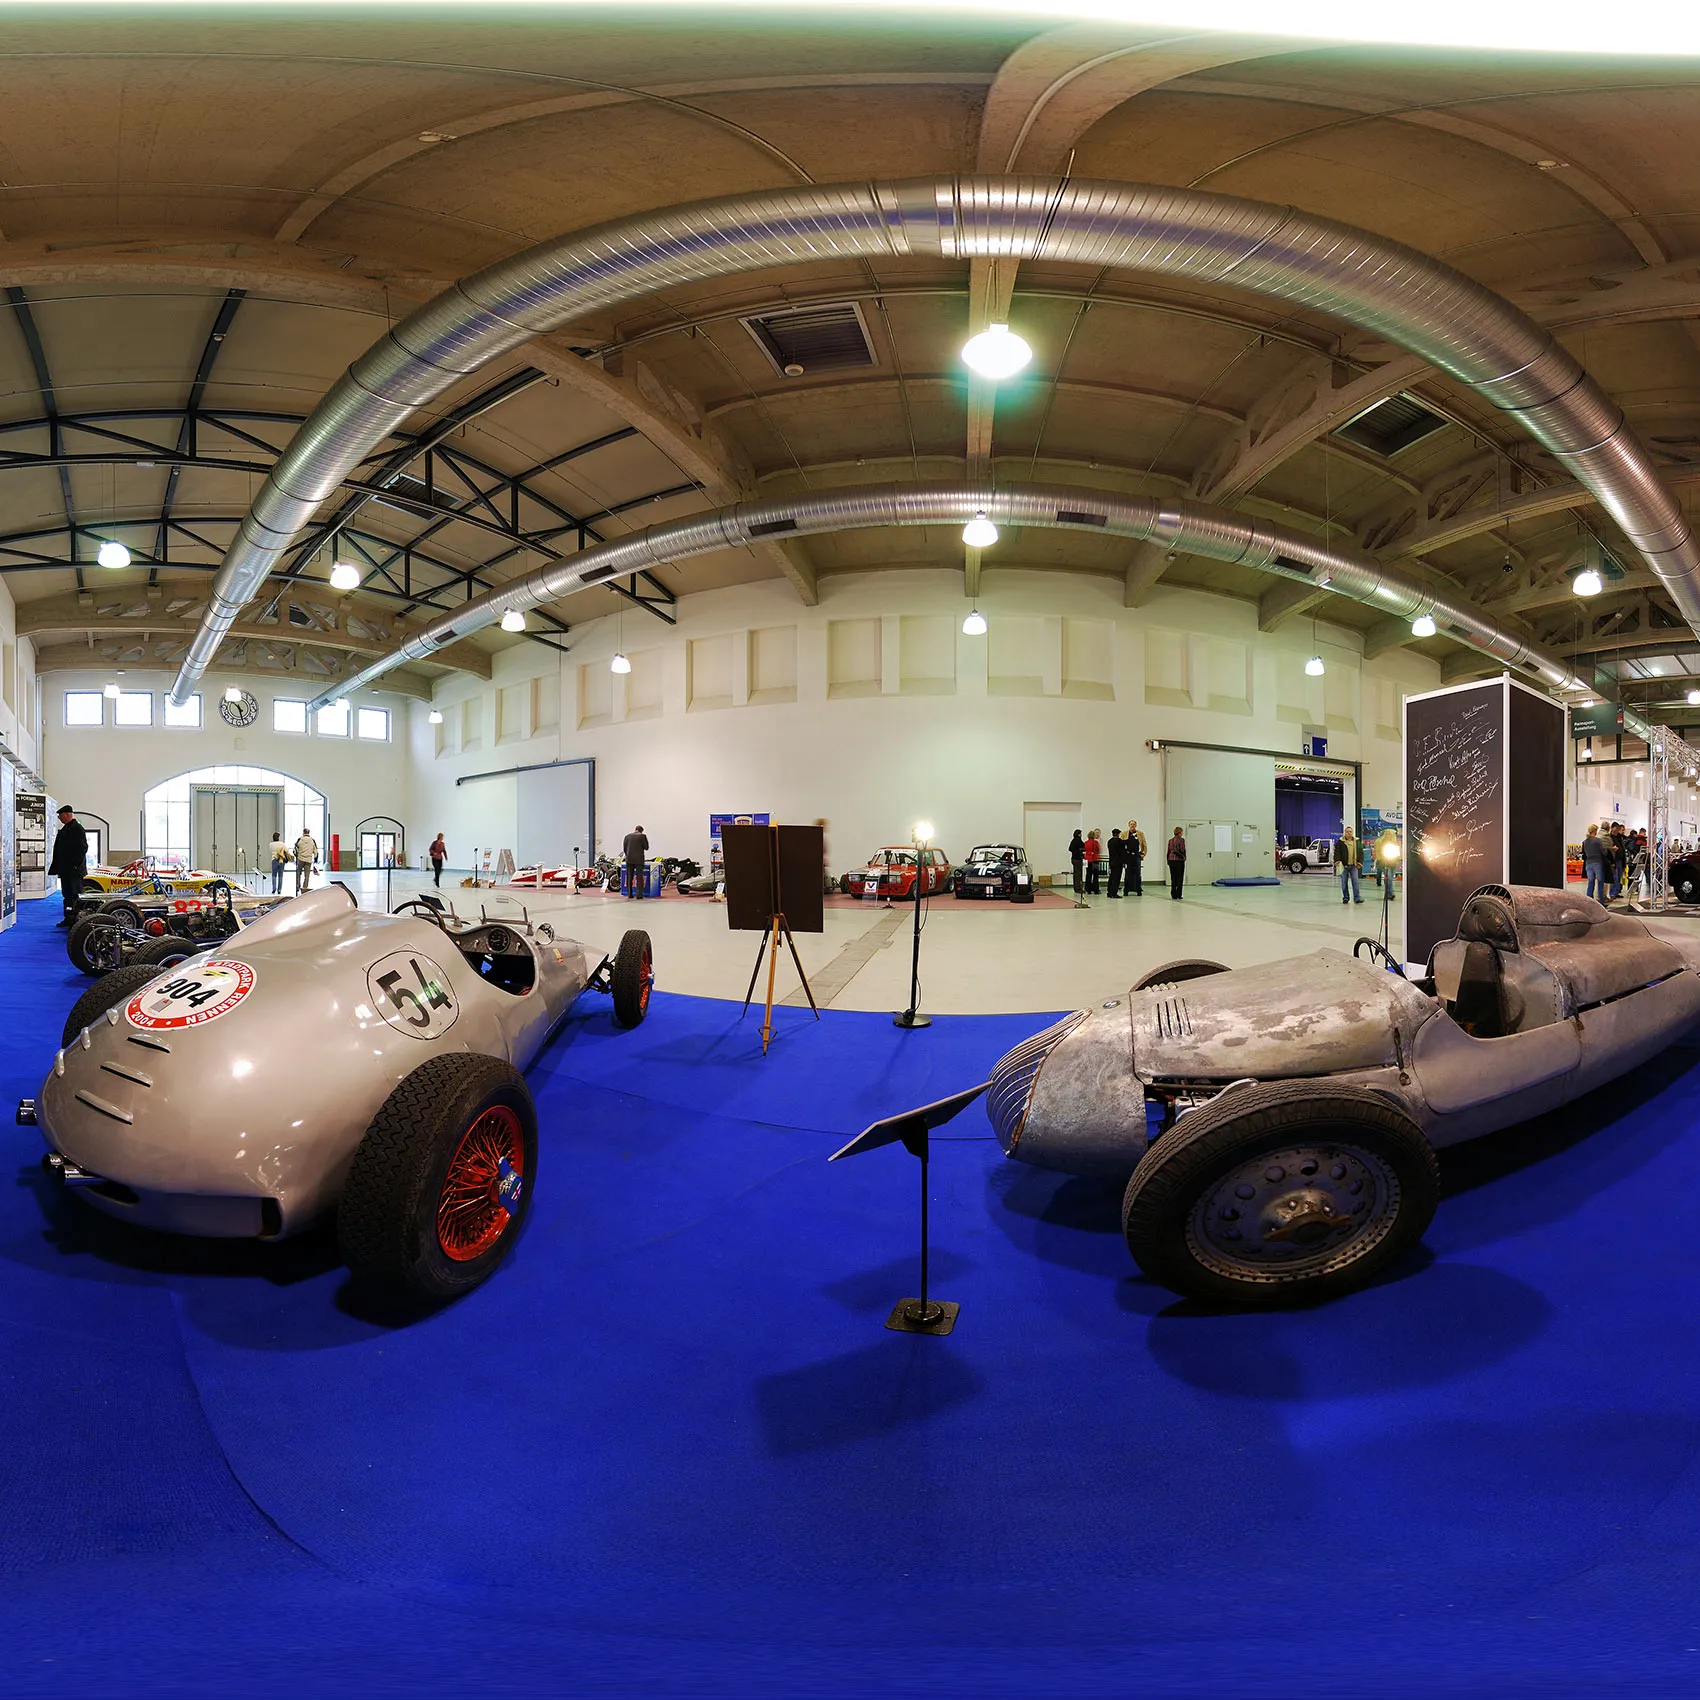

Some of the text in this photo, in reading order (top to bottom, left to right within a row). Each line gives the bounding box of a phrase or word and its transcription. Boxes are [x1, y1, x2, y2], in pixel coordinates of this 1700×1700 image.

[156, 978, 220, 1008] 904
[186, 992, 241, 1025] RENNEN
[376, 958, 453, 1028] 54
[131, 1011, 156, 1027] 2004
